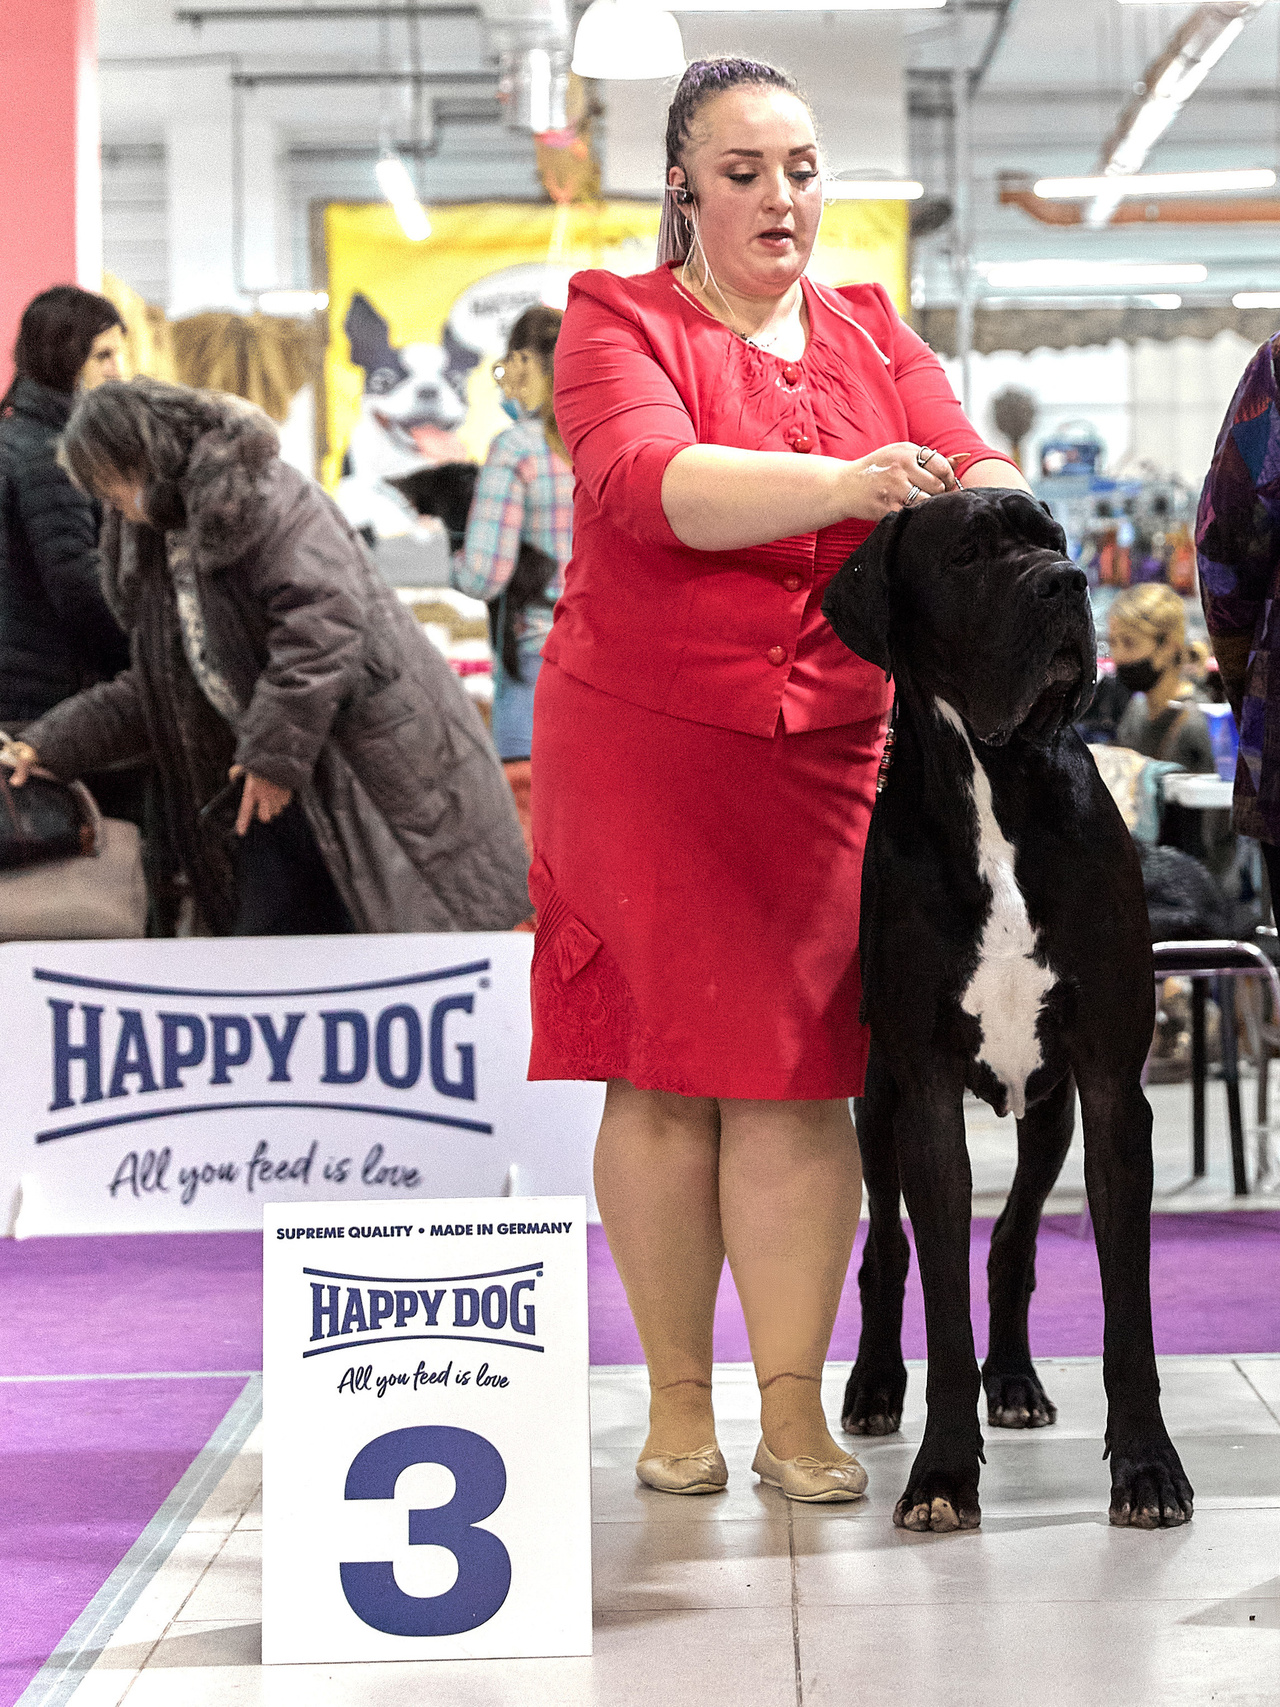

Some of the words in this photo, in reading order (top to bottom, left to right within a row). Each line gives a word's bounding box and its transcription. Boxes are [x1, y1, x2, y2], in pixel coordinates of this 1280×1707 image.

[46, 998, 307, 1112] HAPPY
[108, 1147, 173, 1198] All
[179, 1162, 238, 1206] you
[247, 1139, 319, 1193] feed
[323, 1153, 351, 1185] is
[361, 1142, 423, 1190] love
[276, 1226, 345, 1240] SUPREME
[348, 1225, 414, 1239] QUALITY
[429, 1224, 474, 1237] MADE
[476, 1223, 495, 1236] IN
[496, 1221, 573, 1235] GERMANY
[309, 1281, 447, 1342] HAPPY
[336, 1364, 373, 1394] All
[375, 1372, 411, 1399] you
[412, 1360, 453, 1391] feed
[455, 1366, 472, 1386] is
[475, 1362, 511, 1389] love
[339, 1425, 513, 1638] 3
